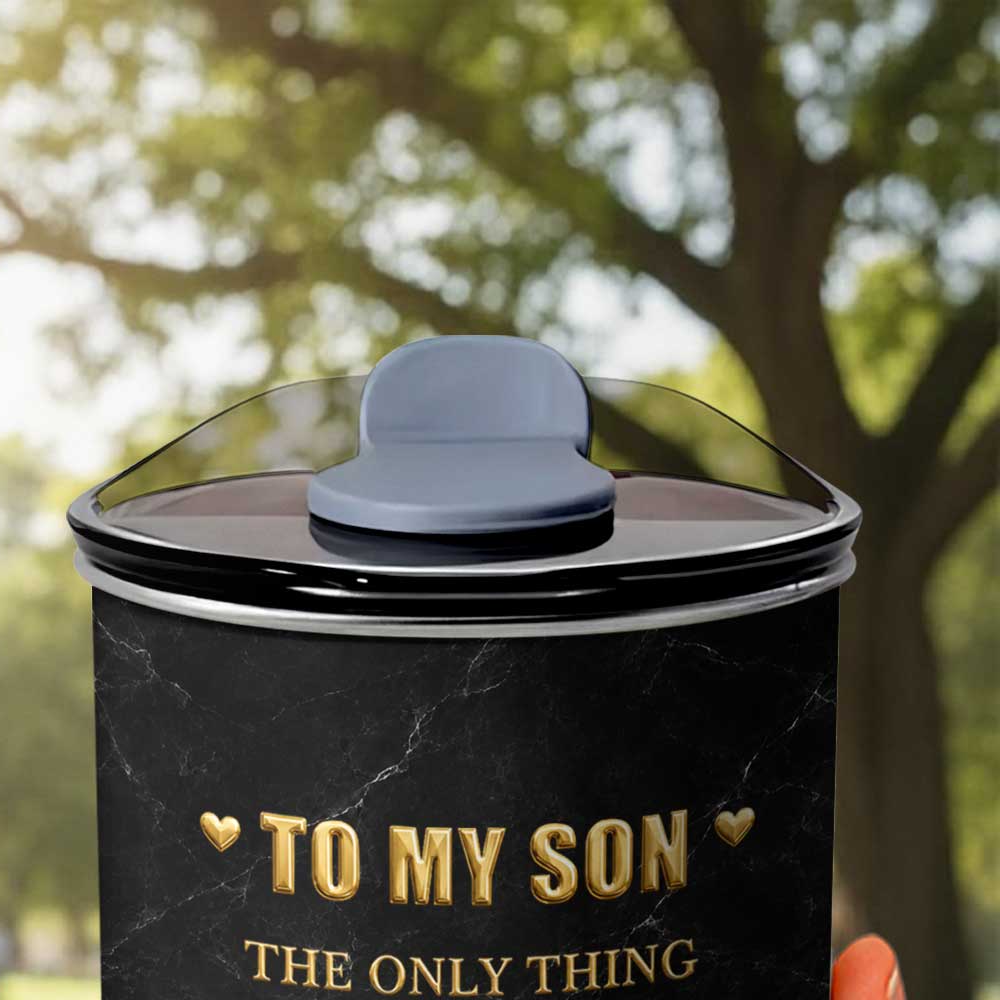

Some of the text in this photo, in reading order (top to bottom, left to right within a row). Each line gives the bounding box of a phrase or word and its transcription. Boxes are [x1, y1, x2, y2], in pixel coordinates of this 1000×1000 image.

[260, 809, 689, 906] TO MY SON
[244, 940, 699, 998] THE ONLY THING
